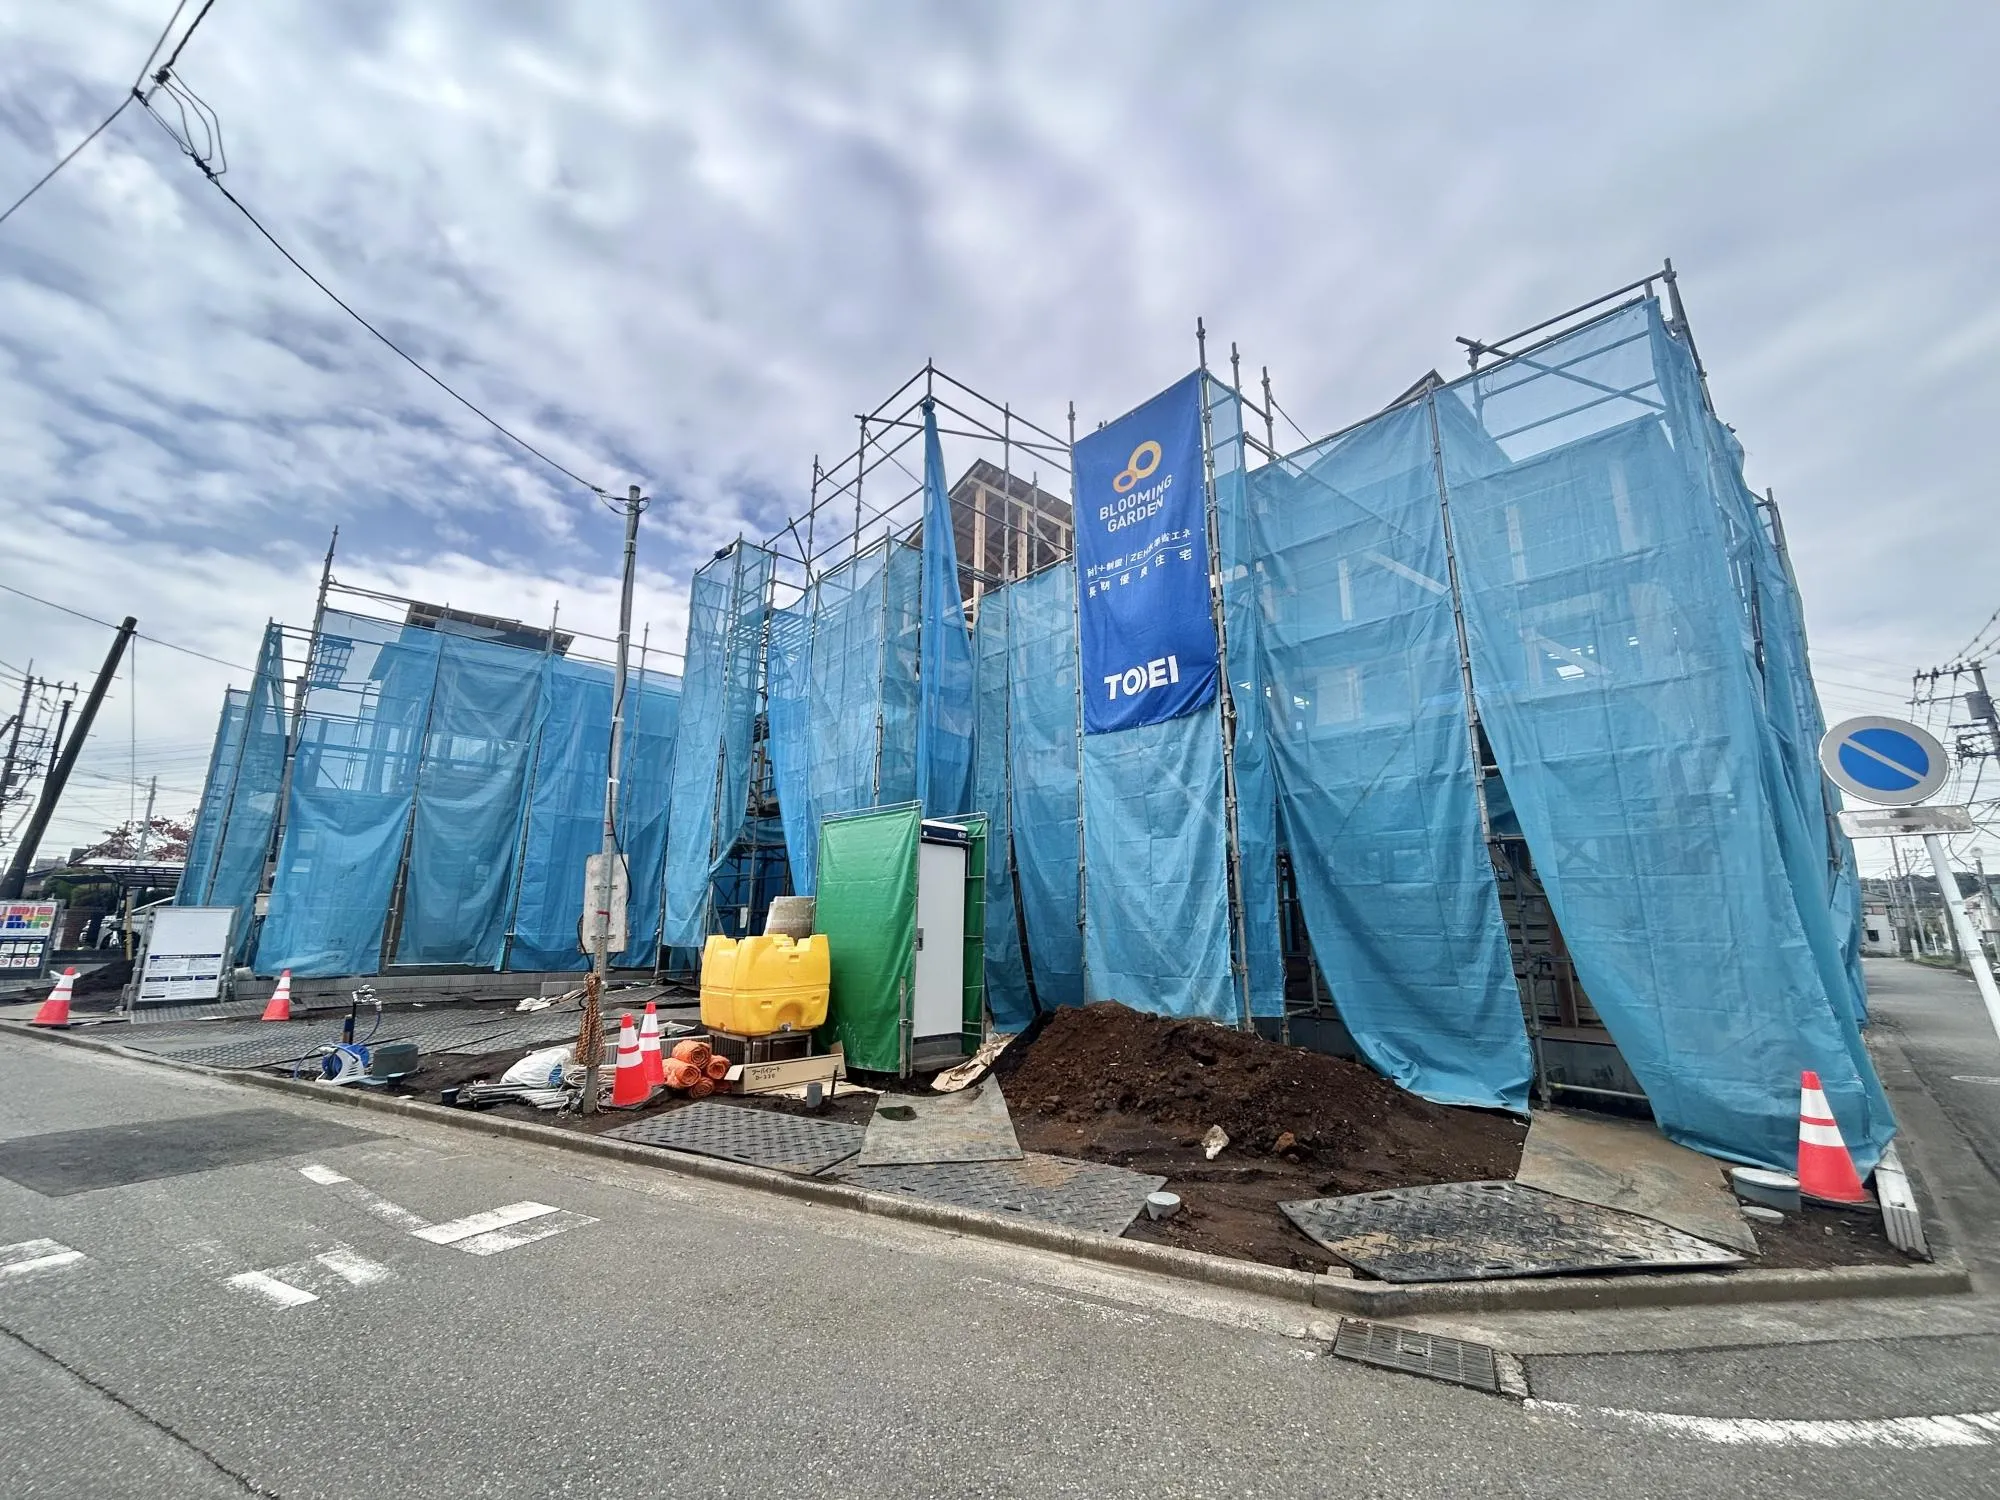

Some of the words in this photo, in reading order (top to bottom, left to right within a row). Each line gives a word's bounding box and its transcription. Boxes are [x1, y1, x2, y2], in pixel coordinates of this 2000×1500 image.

[1099, 474, 1172, 520] BLOOMING
[1107, 495, 1164, 532] GARDEN
[1104, 655, 1179, 700] TOEI
